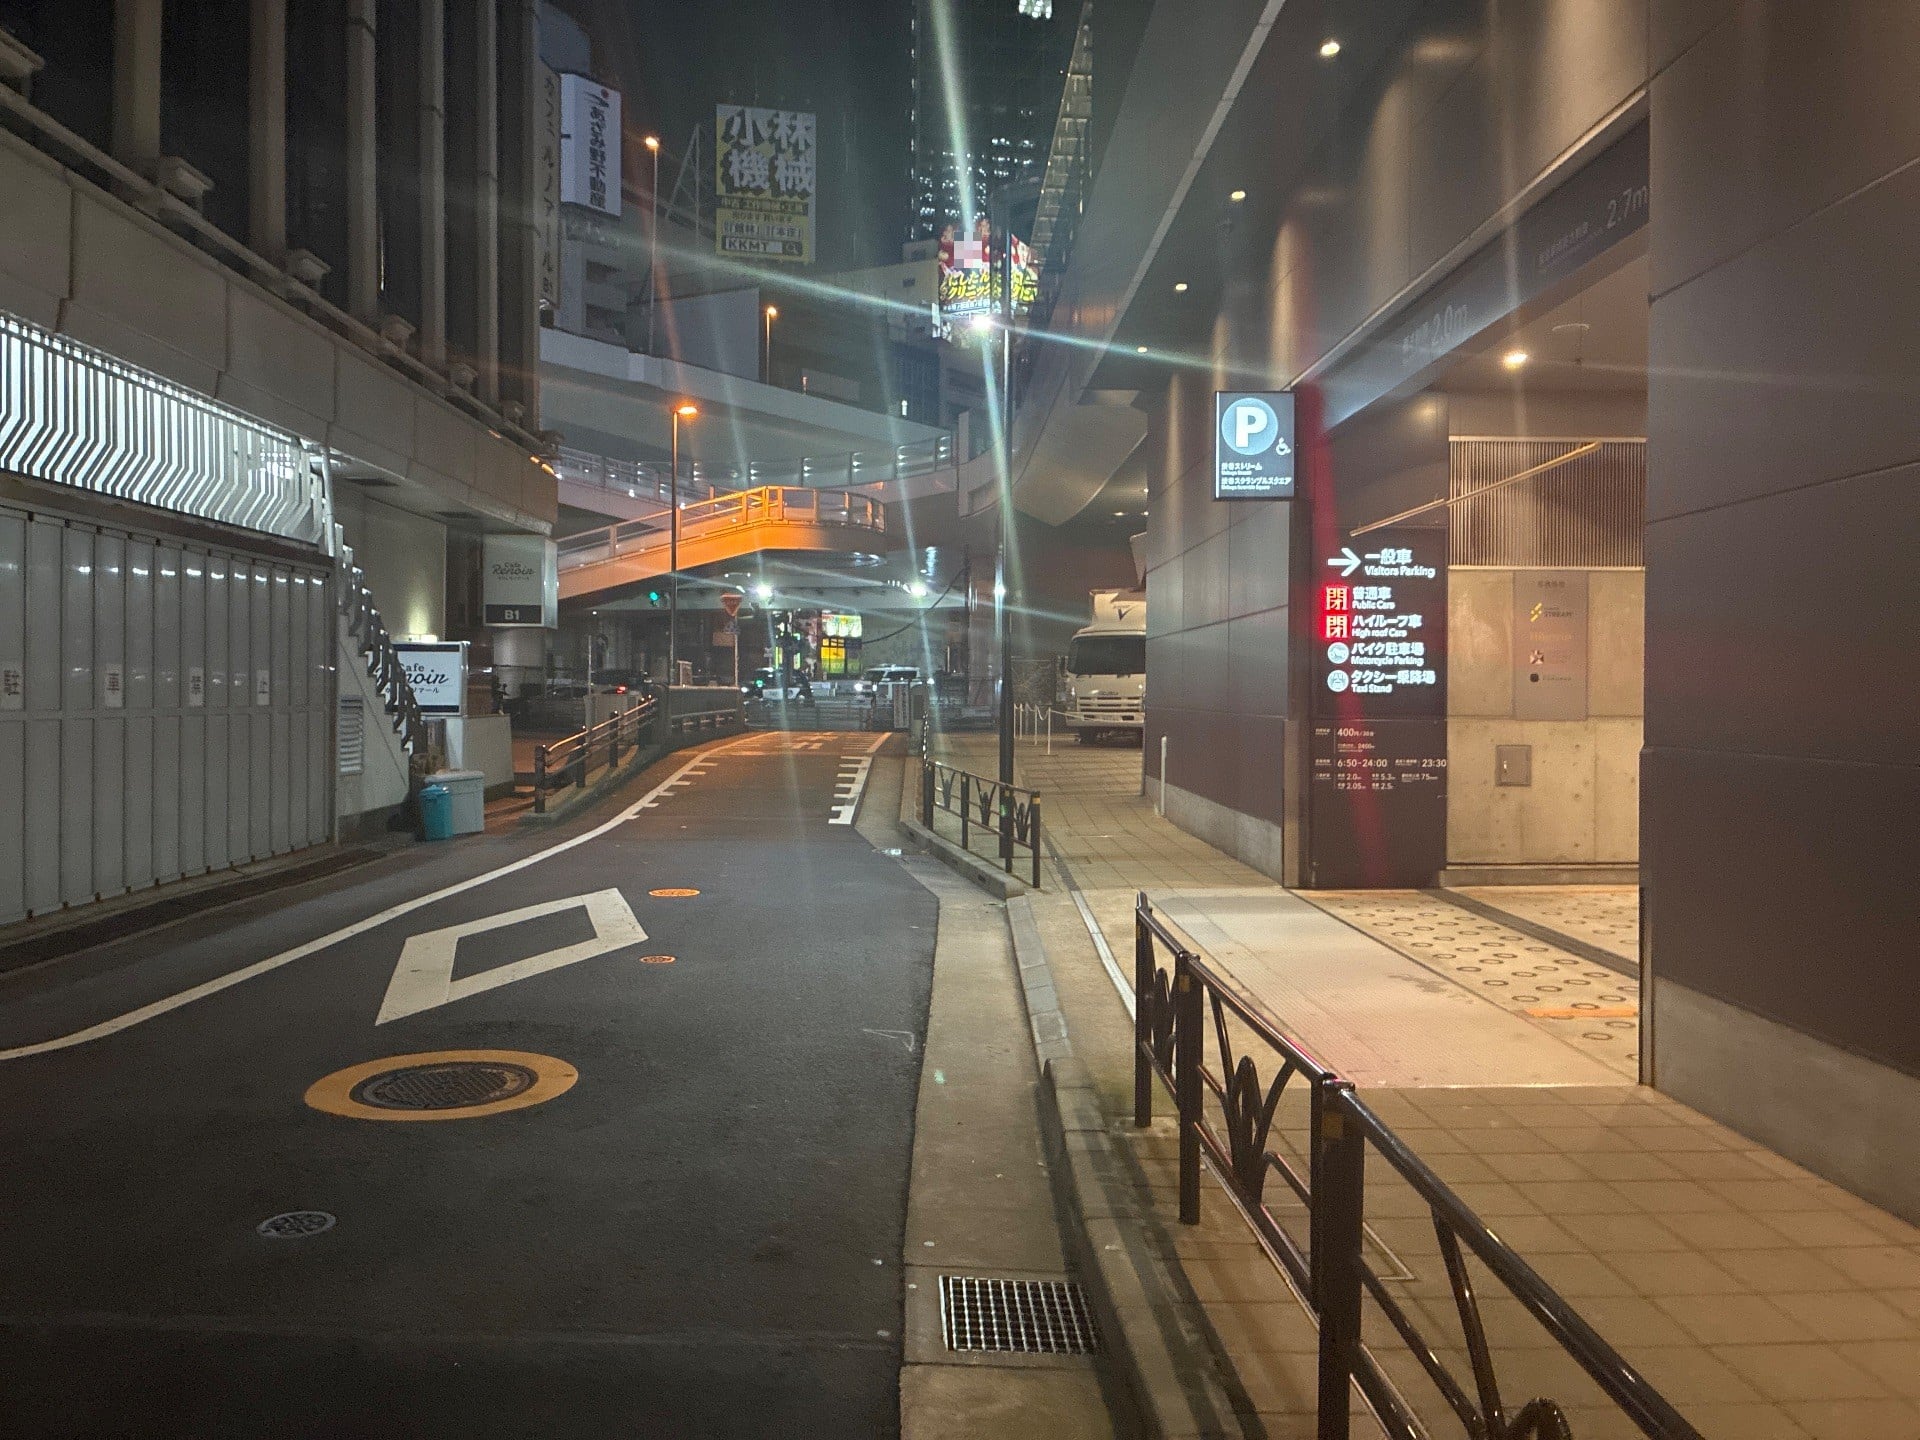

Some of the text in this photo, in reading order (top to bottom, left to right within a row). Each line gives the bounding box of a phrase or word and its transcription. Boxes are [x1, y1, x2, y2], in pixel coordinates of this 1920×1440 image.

[727, 109, 812, 151] 小林
[726, 149, 812, 193] 機械
[1607, 186, 1647, 229] 2.7m
[1236, 406, 1267, 448] P
[1364, 548, 1412, 565] 一般車
[1364, 565, 1436, 579] Visitors Parking
[1325, 586, 1348, 611] 閉
[1352, 600, 1375, 609] Public
[504, 610, 519, 620] B1
[1325, 614, 1422, 638] 閉 ハイルーフ車
[1351, 628, 1371, 639] High
[1351, 642, 1424, 656] バイク駐車場
[1350, 656, 1425, 667] Motorcycle Parking
[1351, 684, 1392, 693] Taxi Stand
[1421, 759, 1447, 767] 23:30
